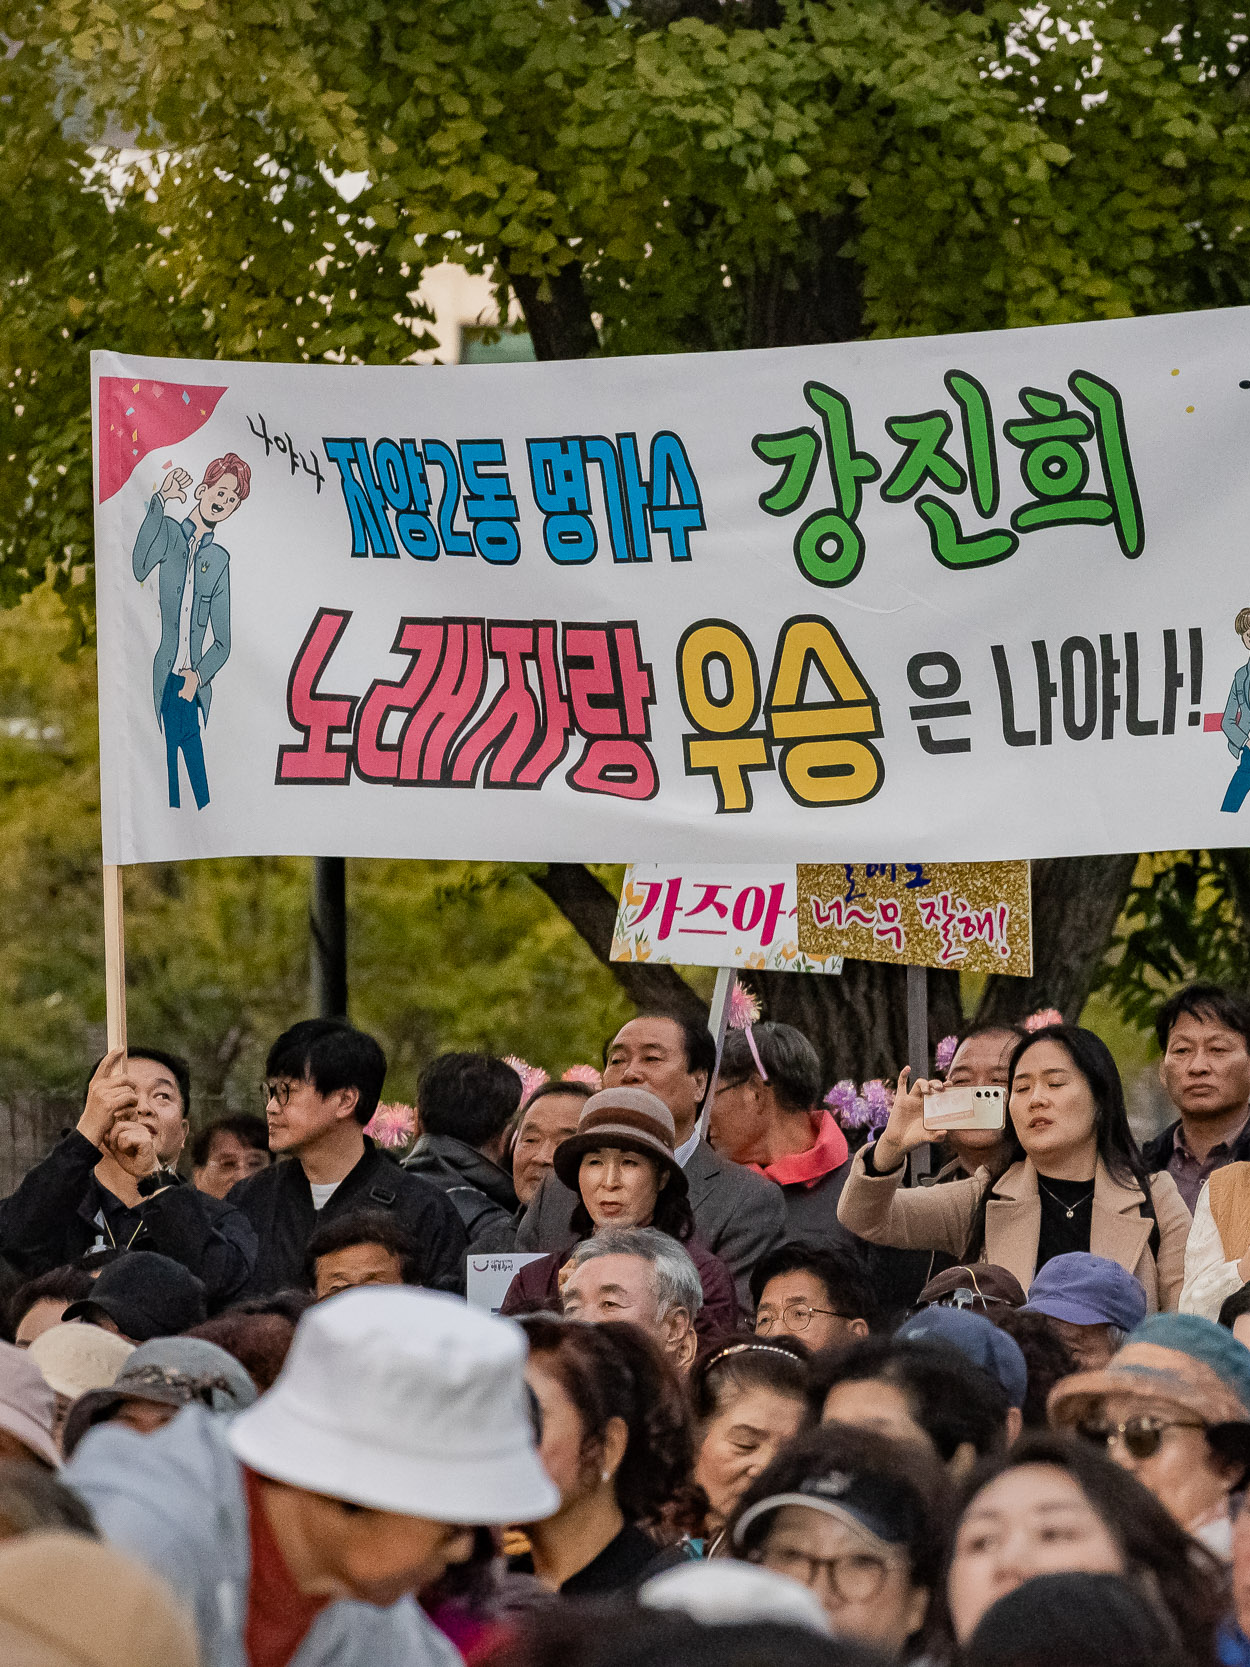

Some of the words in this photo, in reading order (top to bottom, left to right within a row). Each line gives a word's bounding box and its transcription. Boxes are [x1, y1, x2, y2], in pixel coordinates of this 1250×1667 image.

[246, 412, 325, 494] 나야나
[322, 436, 521, 566] 자양2동
[525, 430, 708, 566] 명가수
[751, 369, 1145, 588] 강진희
[274, 607, 660, 801] 노래자랑
[675, 613, 886, 814] 우승
[906, 650, 972, 755] 은
[990, 627, 1204, 748] 나야나!
[916, 892, 1010, 964] 잘해!
